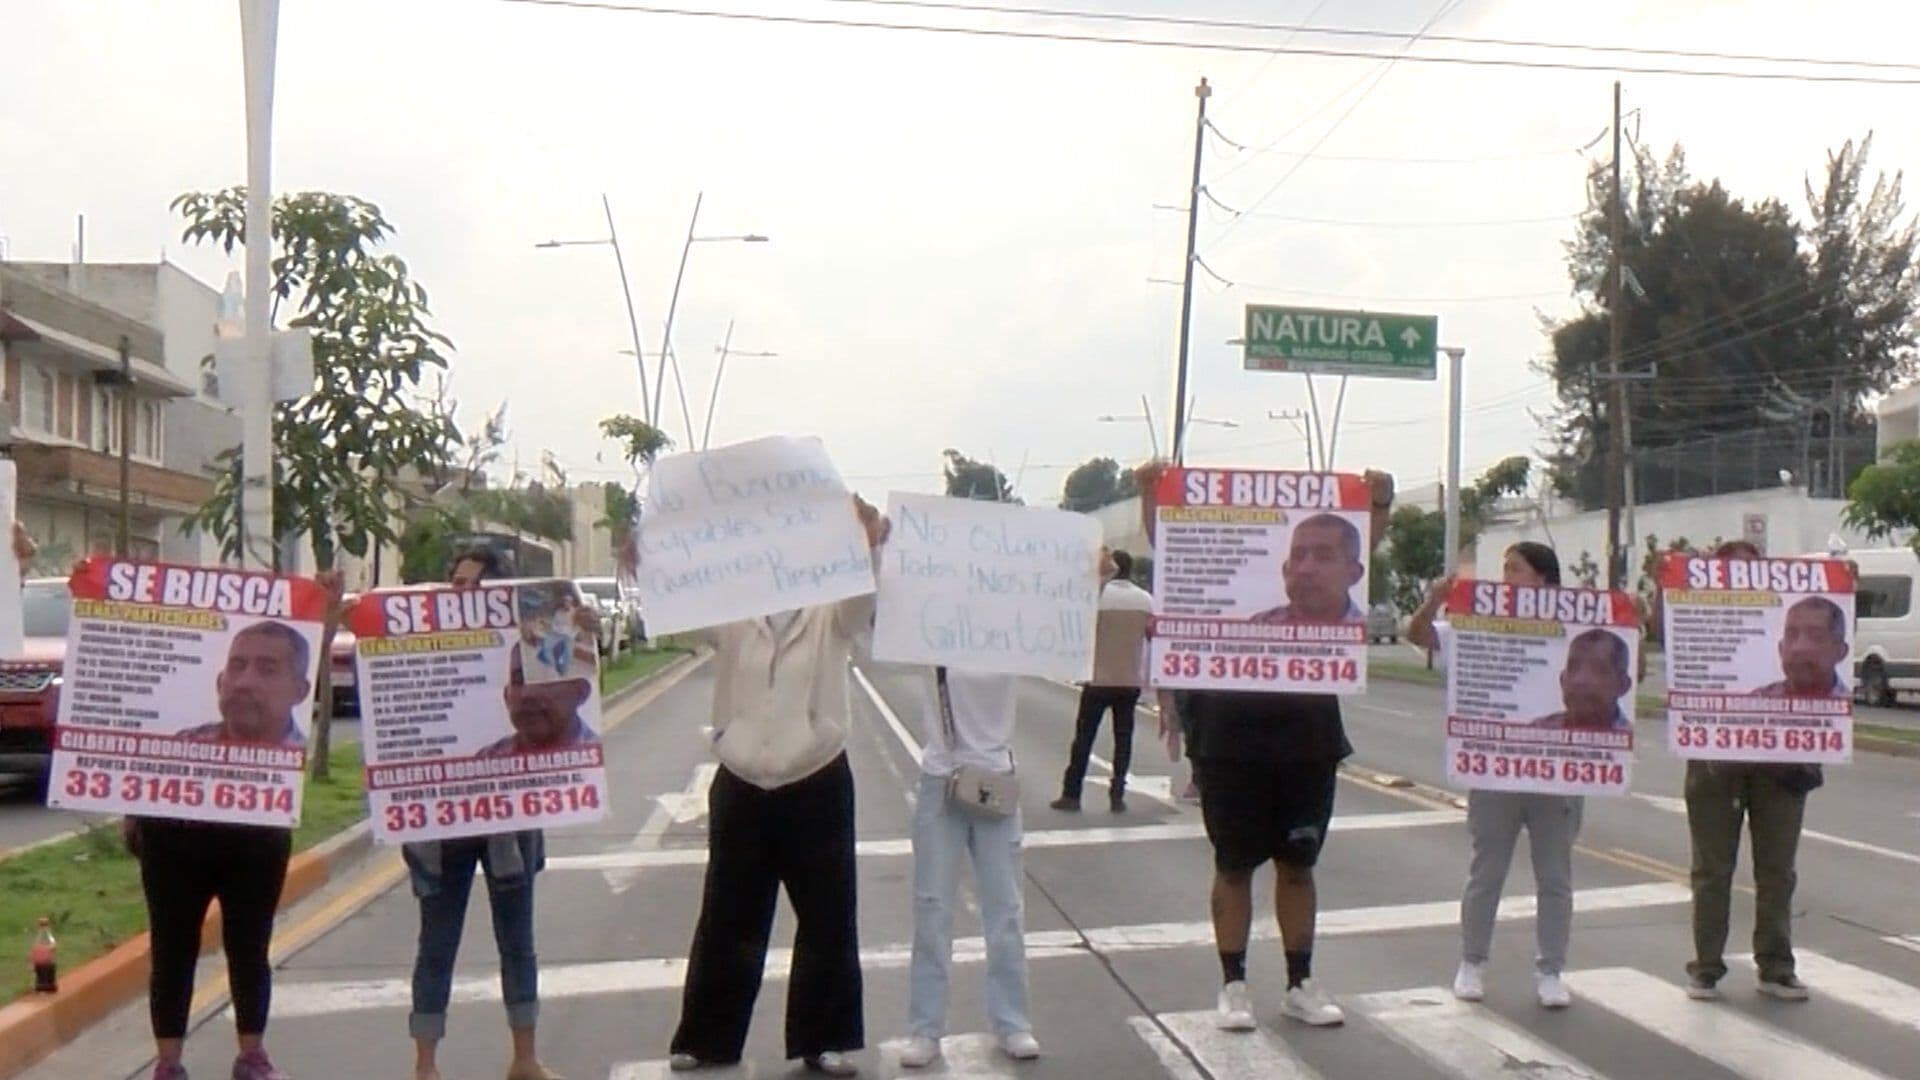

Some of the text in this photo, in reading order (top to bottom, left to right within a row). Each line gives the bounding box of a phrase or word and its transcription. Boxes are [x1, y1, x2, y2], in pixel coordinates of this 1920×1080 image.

[1251, 312, 1386, 347] NATURA
[1185, 471, 1342, 508] SE BUSCA
[898, 504, 947, 545] No
[108, 562, 292, 617] SE BUSCA
[1688, 559, 1829, 592] SE BUSCA
[385, 588, 518, 634] SE BUS
[1474, 584, 1614, 624] SE BUSCA
[1163, 653, 1358, 682] 33 3145 6314
[61, 732, 137, 755] GILBERTO
[228, 745, 303, 767] BALDERAS
[1678, 727, 1844, 751] 33 3145 6314
[373, 766, 443, 786] GILBERTO
[1455, 752, 1623, 785] 33 3145 6314
[65, 770, 294, 813] 33 3145 6314
[387, 784, 600, 832] 33 3145 6314
